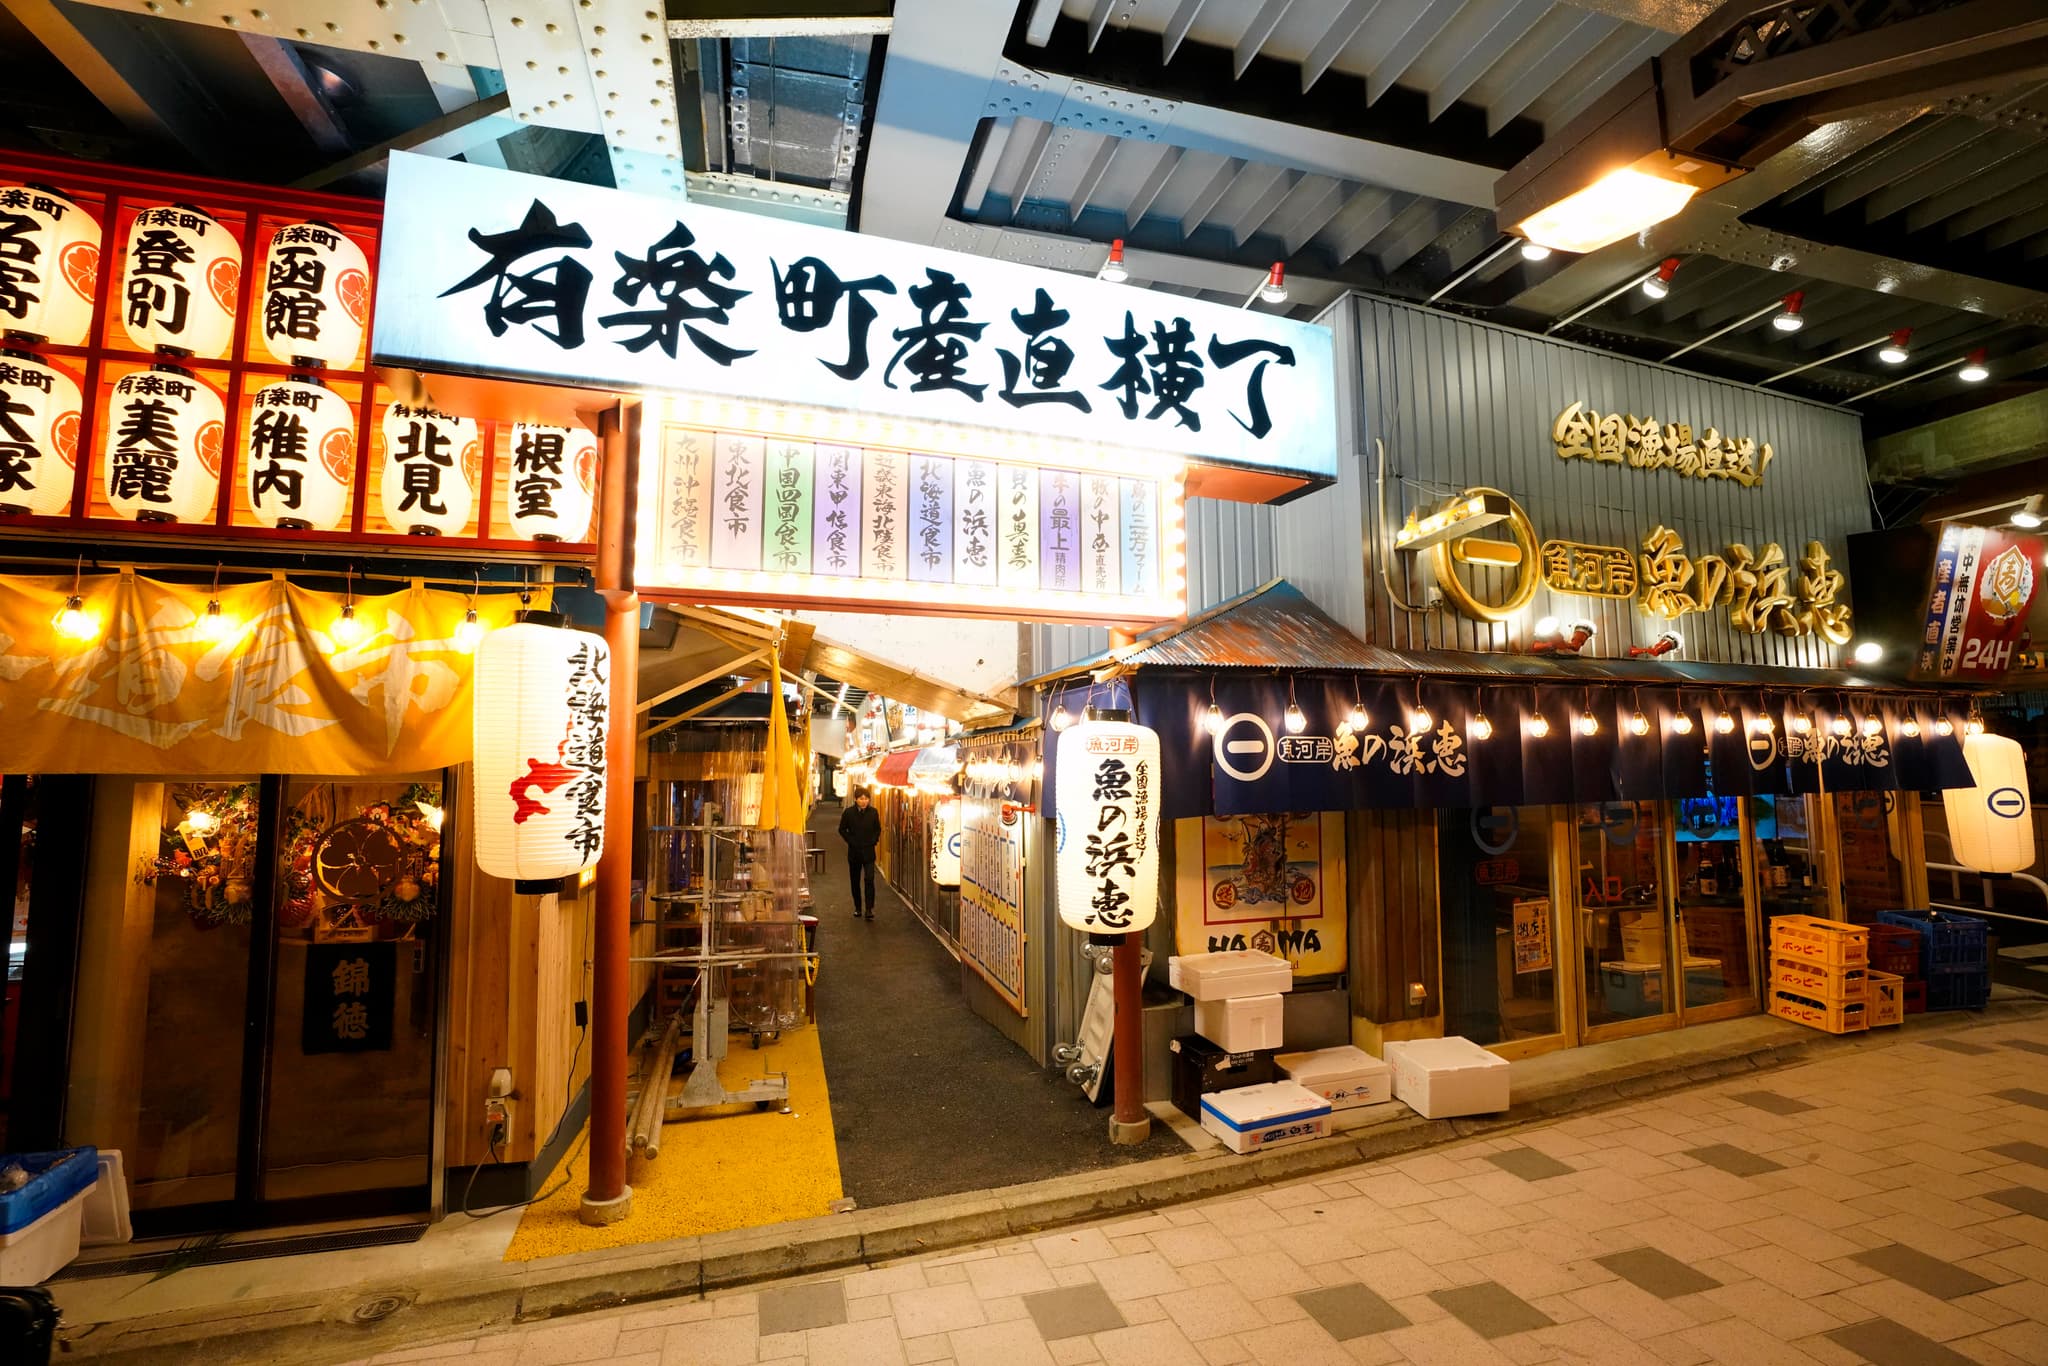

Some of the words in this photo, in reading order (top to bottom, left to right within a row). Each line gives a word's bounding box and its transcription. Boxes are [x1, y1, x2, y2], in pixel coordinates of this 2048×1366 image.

[0, 189, 69, 221] 楽町
[134, 207, 210, 236] 有楽町
[271, 223, 342, 251] 有楽町
[128, 230, 195, 333] 登別
[264, 247, 327, 341] 函館
[437, 198, 1296, 439] 有楽町産直横丁
[117, 374, 196, 403] 有楽町
[254, 388, 322, 412] 有楽町
[111, 398, 178, 503] 美麗
[251, 409, 309, 509] 稚内
[395, 421, 453, 514] 北見
[514, 432, 565, 518] 根室
[723, 440, 752, 539] 東北食市
[773, 444, 801, 570] 中国四国食市
[826, 449, 849, 572] 関東甲信食市
[920, 460, 944, 571] 北海道食市
[962, 461, 989, 568] 魚の浜恵
[1547, 544, 1634, 594] 魚河岸
[1639, 525, 1852, 645] 魚の浜恵
[1962, 638, 2014, 670] 24H
[1089, 738, 1138, 752] 魚河岸
[1280, 738, 1332, 760] 魚河岸
[1332, 720, 1467, 777] 魚の浜恵
[1085, 758, 1136, 928] 魚の浜恵
[1782, 942, 1824, 955] ホッピー
[1782, 974, 1824, 988] ホッピー
[1781, 1006, 1823, 1021] ホッピー
